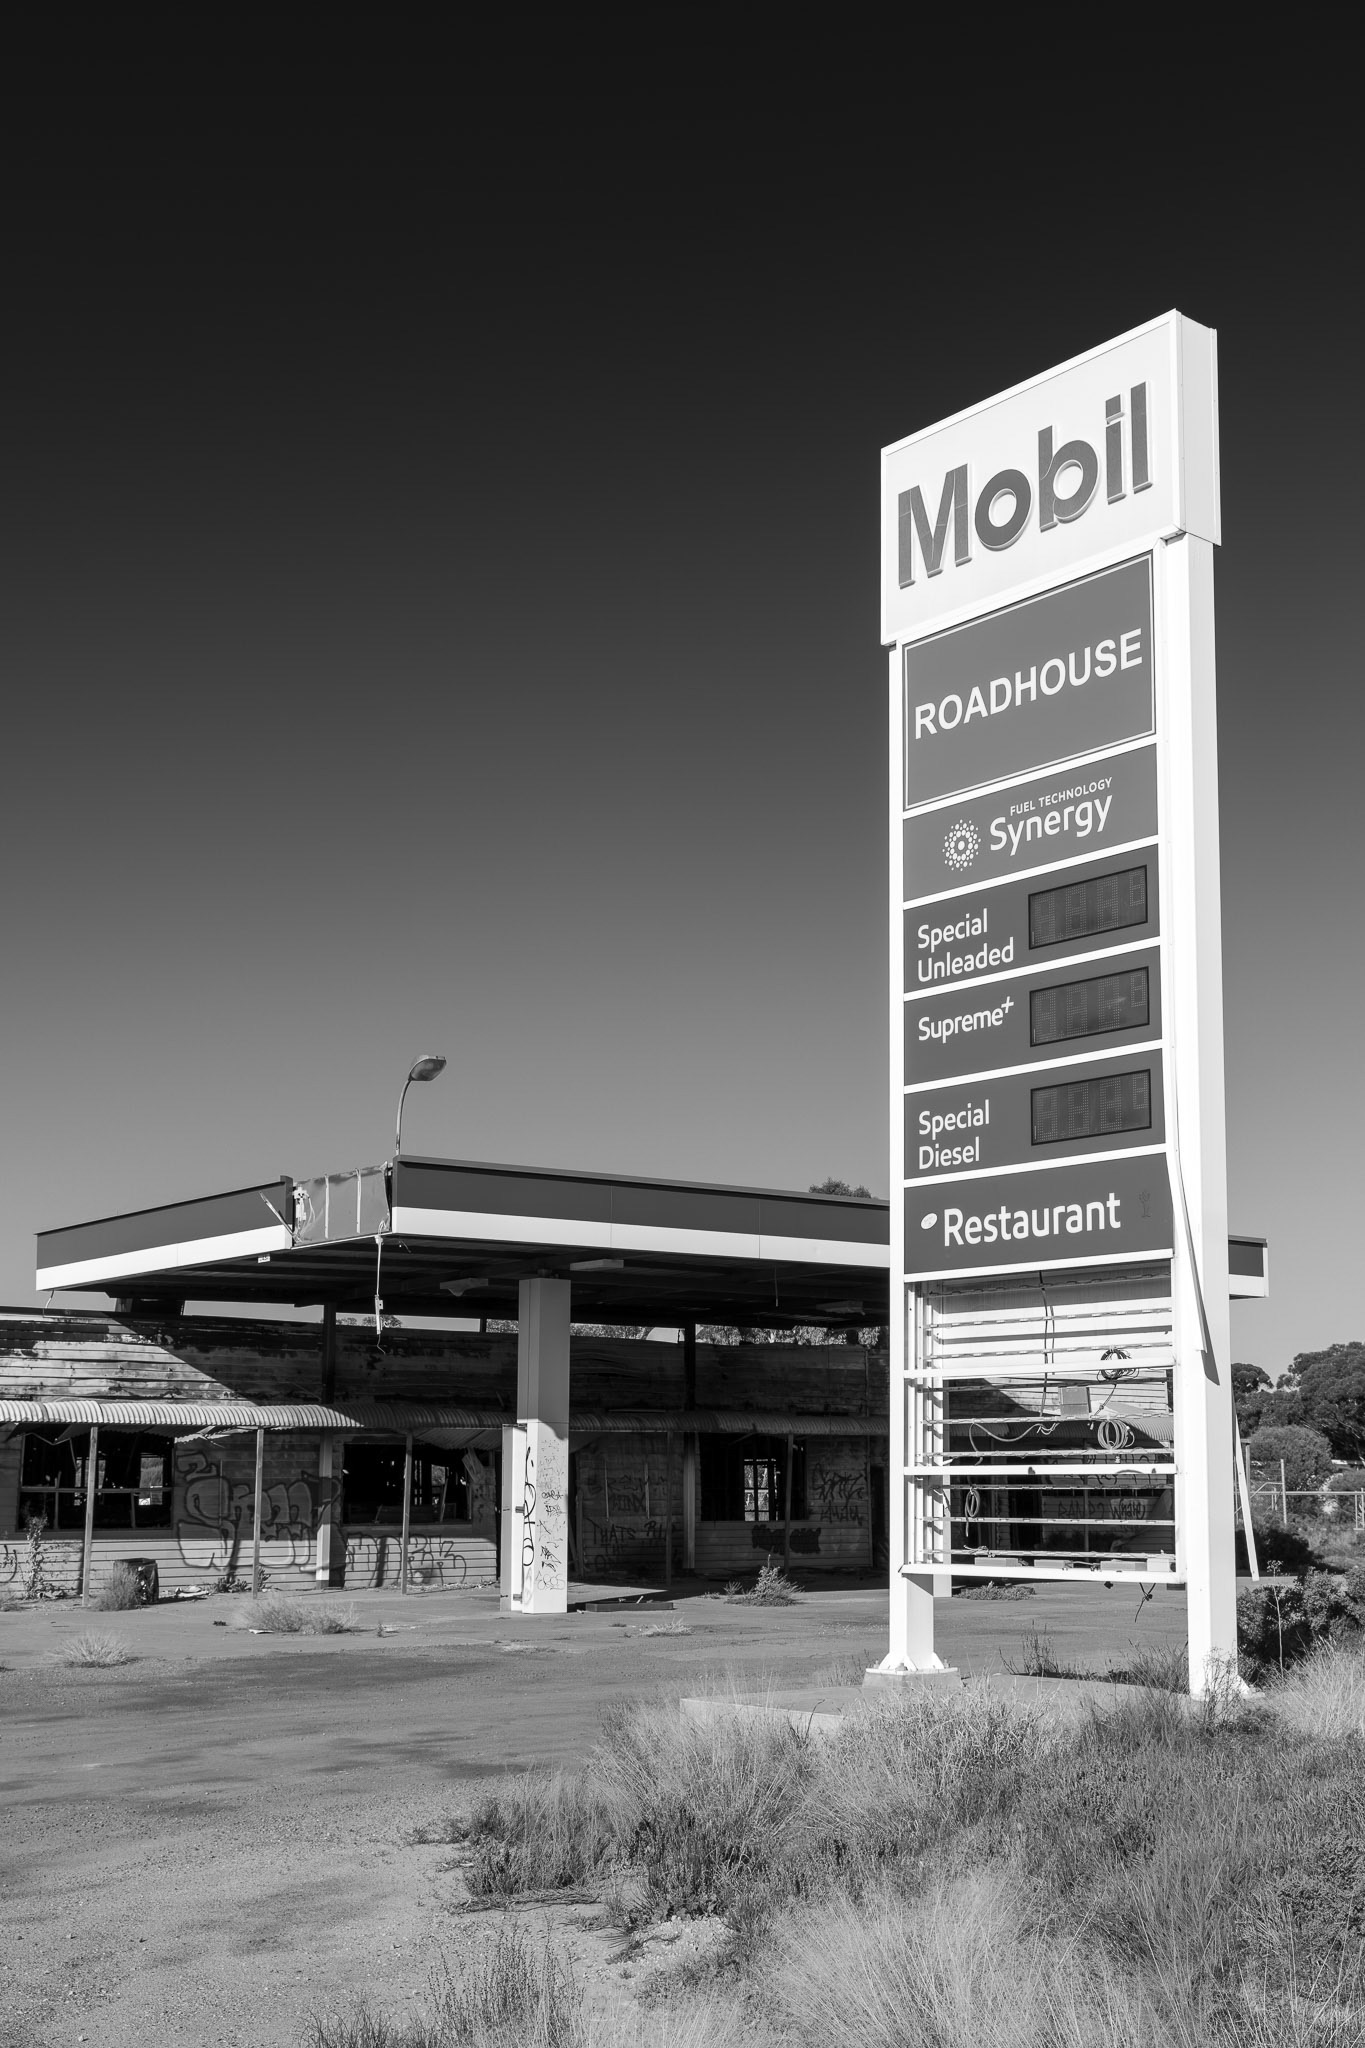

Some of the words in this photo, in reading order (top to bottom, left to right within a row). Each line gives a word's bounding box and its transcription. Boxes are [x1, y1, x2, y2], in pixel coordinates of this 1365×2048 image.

[898, 381, 1152, 589] Mobil
[914, 627, 1144, 740] ROADHOUSE
[1009, 801, 1036, 817] FUEL
[1038, 777, 1112, 809] TECHNOLOGY
[989, 795, 1113, 857] Synergy
[917, 907, 988, 953] Special
[917, 936, 1014, 983] Unleaded
[918, 1098, 990, 1140] Special
[918, 1136, 980, 1170] Diesel
[943, 1192, 1122, 1247] Restaurant
